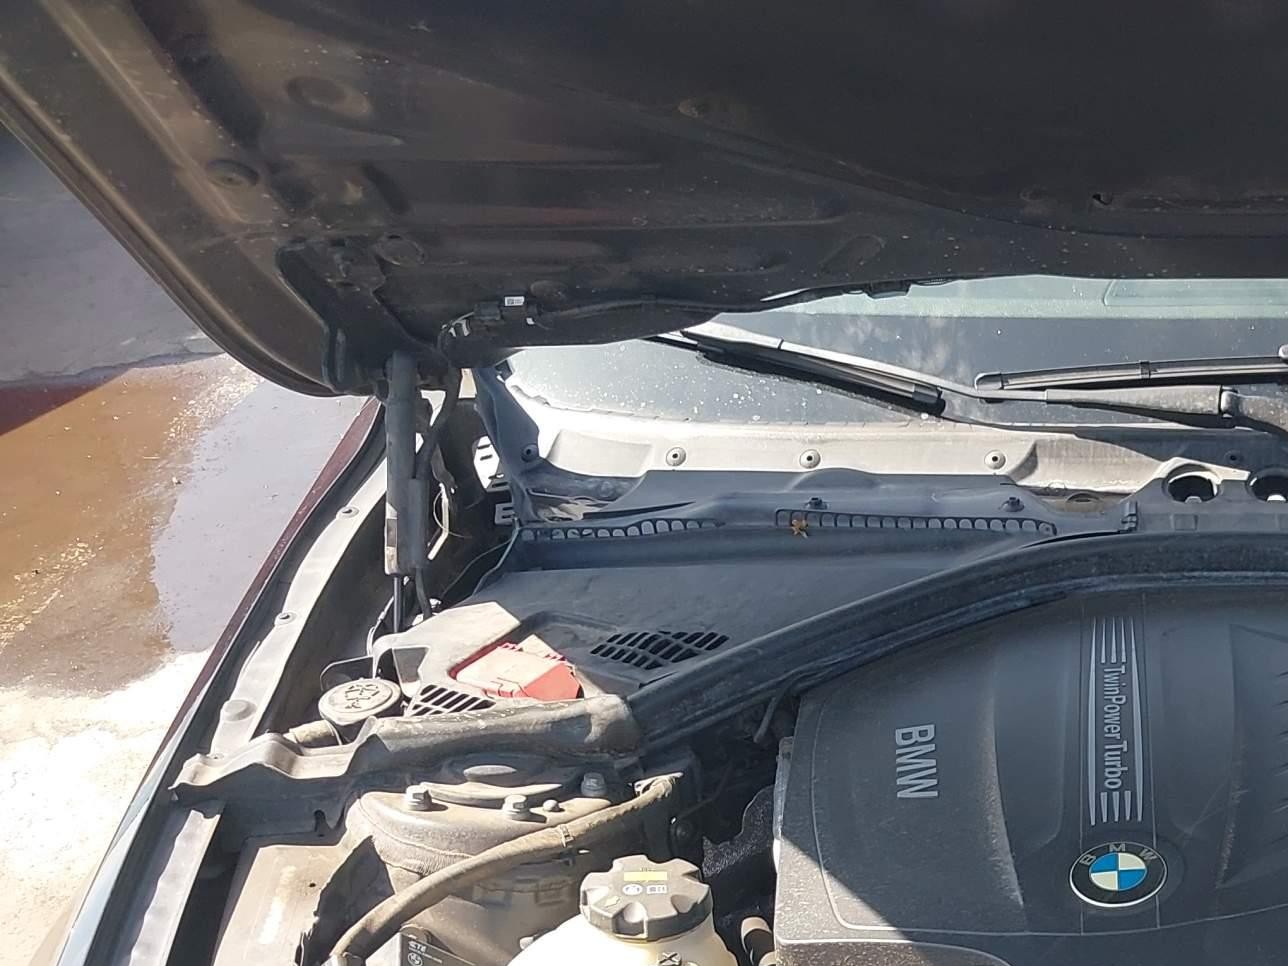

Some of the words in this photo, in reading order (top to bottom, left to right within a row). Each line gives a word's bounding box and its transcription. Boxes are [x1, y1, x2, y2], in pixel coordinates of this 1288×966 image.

[1103, 664, 1127, 739] TwinPower
[895, 724, 939, 798] BMW
[1103, 740, 1128, 790] Turbo
[1079, 842, 1158, 867] BMW
